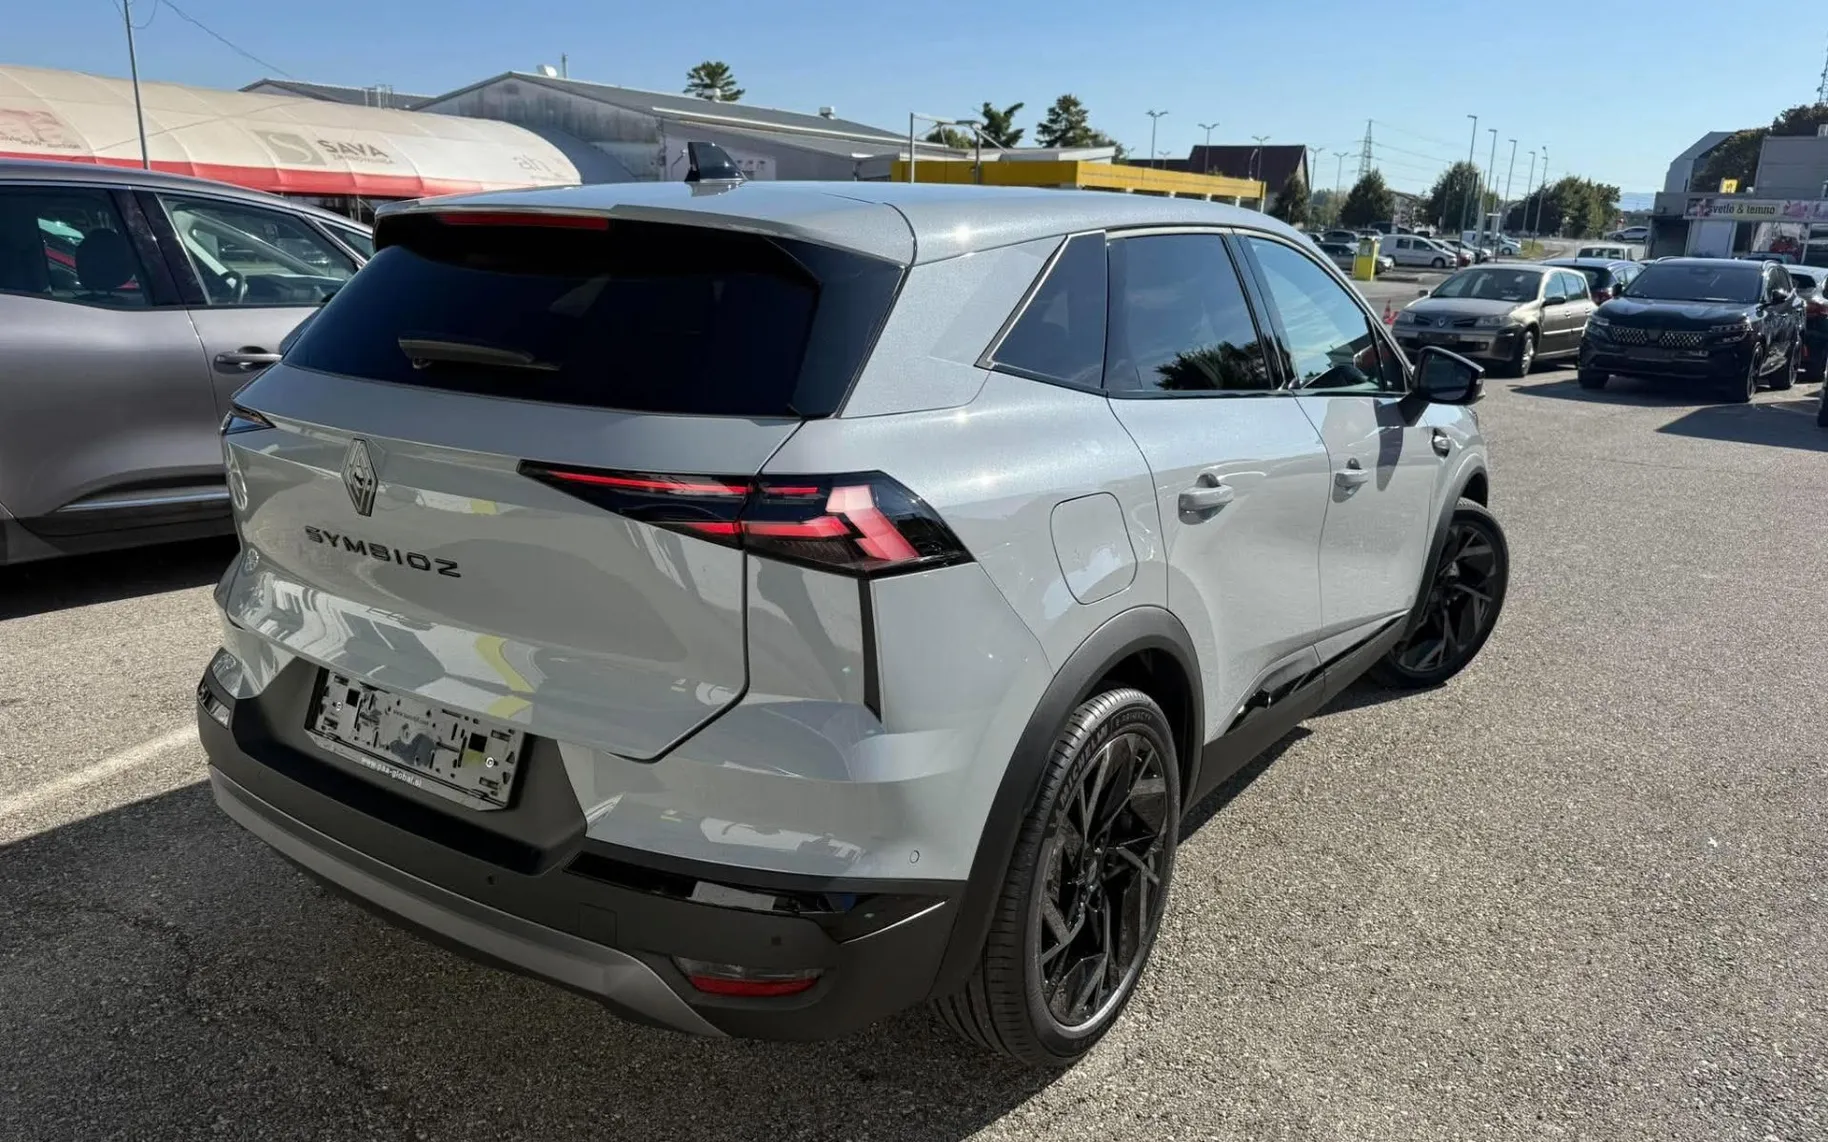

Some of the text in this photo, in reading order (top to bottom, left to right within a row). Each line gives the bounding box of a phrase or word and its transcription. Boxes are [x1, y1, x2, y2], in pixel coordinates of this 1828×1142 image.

[317, 140, 389, 158] SAVA
[1736, 204, 1744, 214] &
[304, 525, 462, 578] SYMBIOZ
[1059, 723, 1108, 809] MICHELIN
